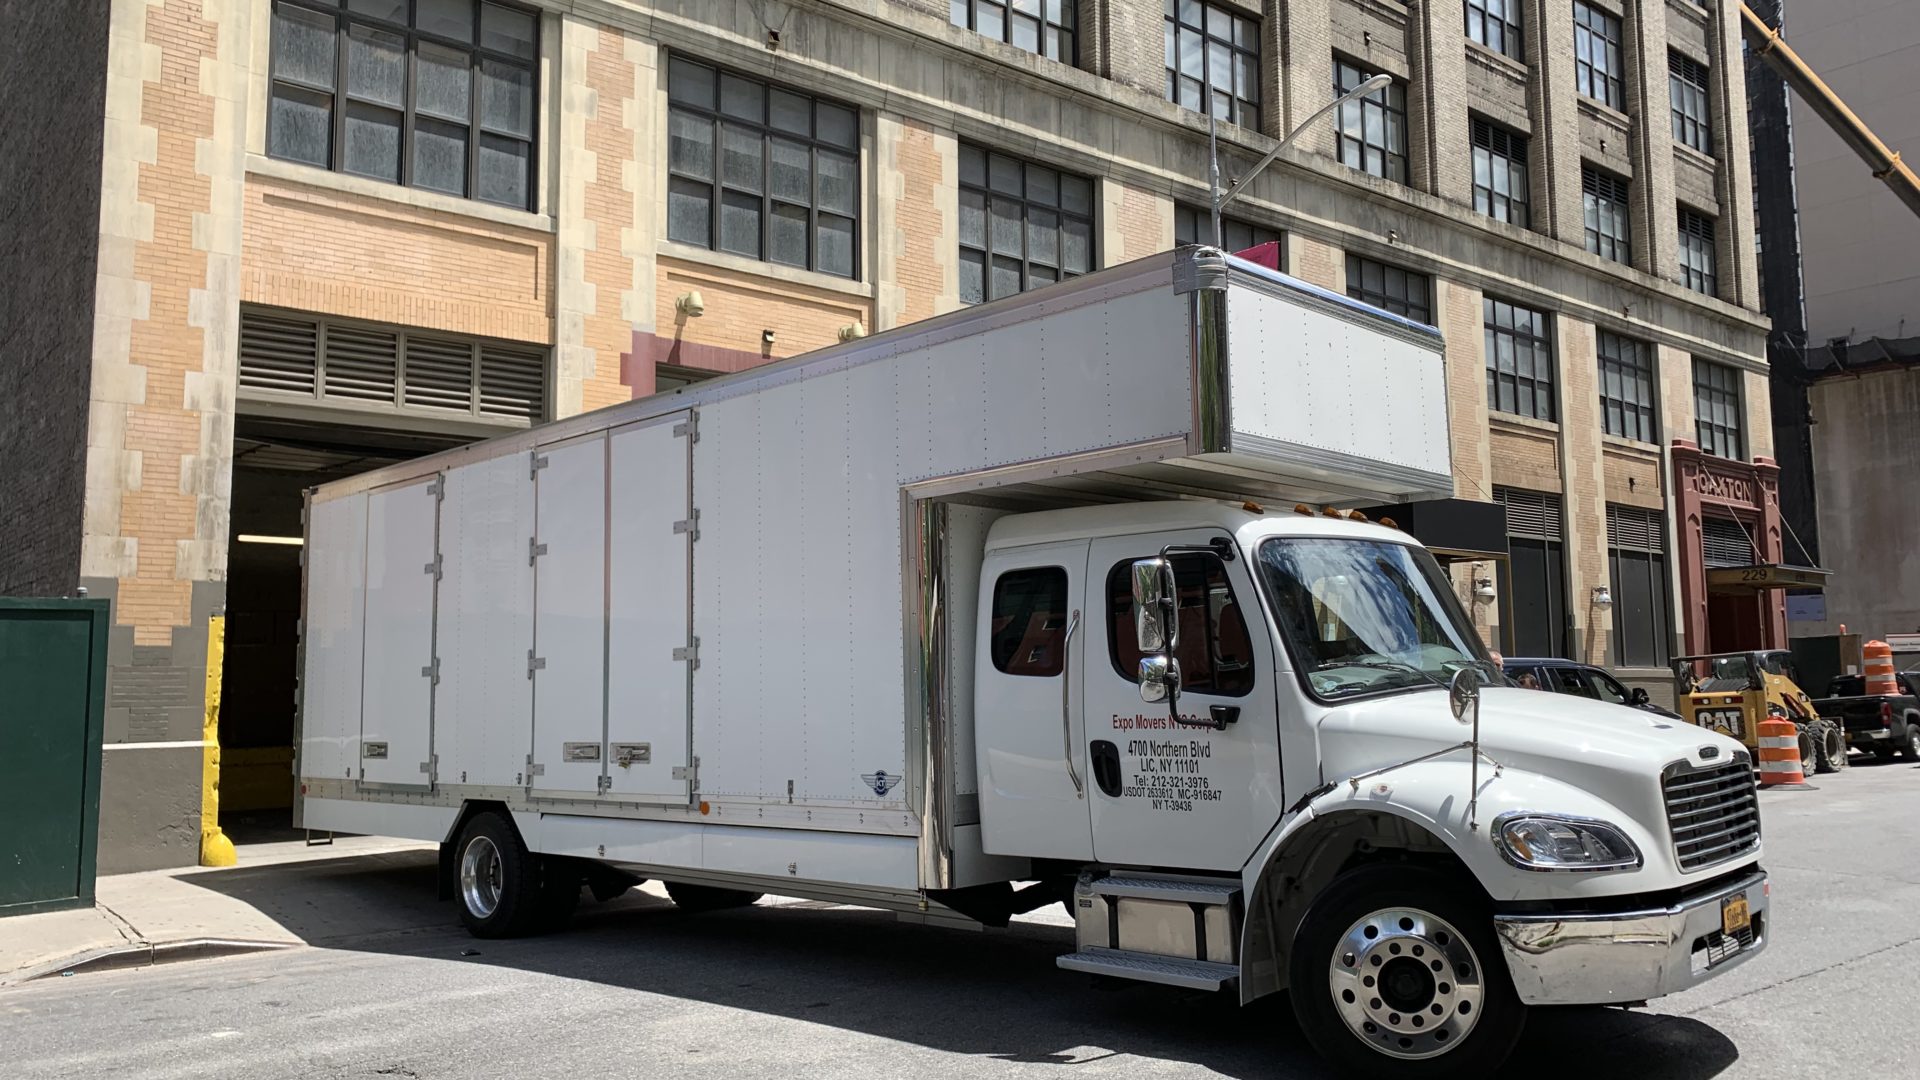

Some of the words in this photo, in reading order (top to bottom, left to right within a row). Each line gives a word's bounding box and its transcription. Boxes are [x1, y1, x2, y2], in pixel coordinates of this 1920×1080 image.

[1741, 568, 1767, 581] 229
[1112, 714, 1134, 733] Expo
[1135, 714, 1167, 730] Movers
[1698, 711, 1740, 736] CAT
[1128, 740, 1148, 757] 4700
[1149, 740, 1188, 757] Northern
[1190, 741, 1211, 758] Blvd
[1140, 758, 1158, 775] LIC,
[1160, 759, 1173, 773] NY
[1174, 759, 1200, 774] 11101
[1133, 775, 1149, 787] Tel:
[1151, 775, 1209, 789] 212-321-3976
[1123, 786, 1146, 798] USDOT
[1177, 789, 1222, 801] MC-916847
[1152, 799, 1163, 810] NY
[1164, 800, 1193, 812] T-39436
